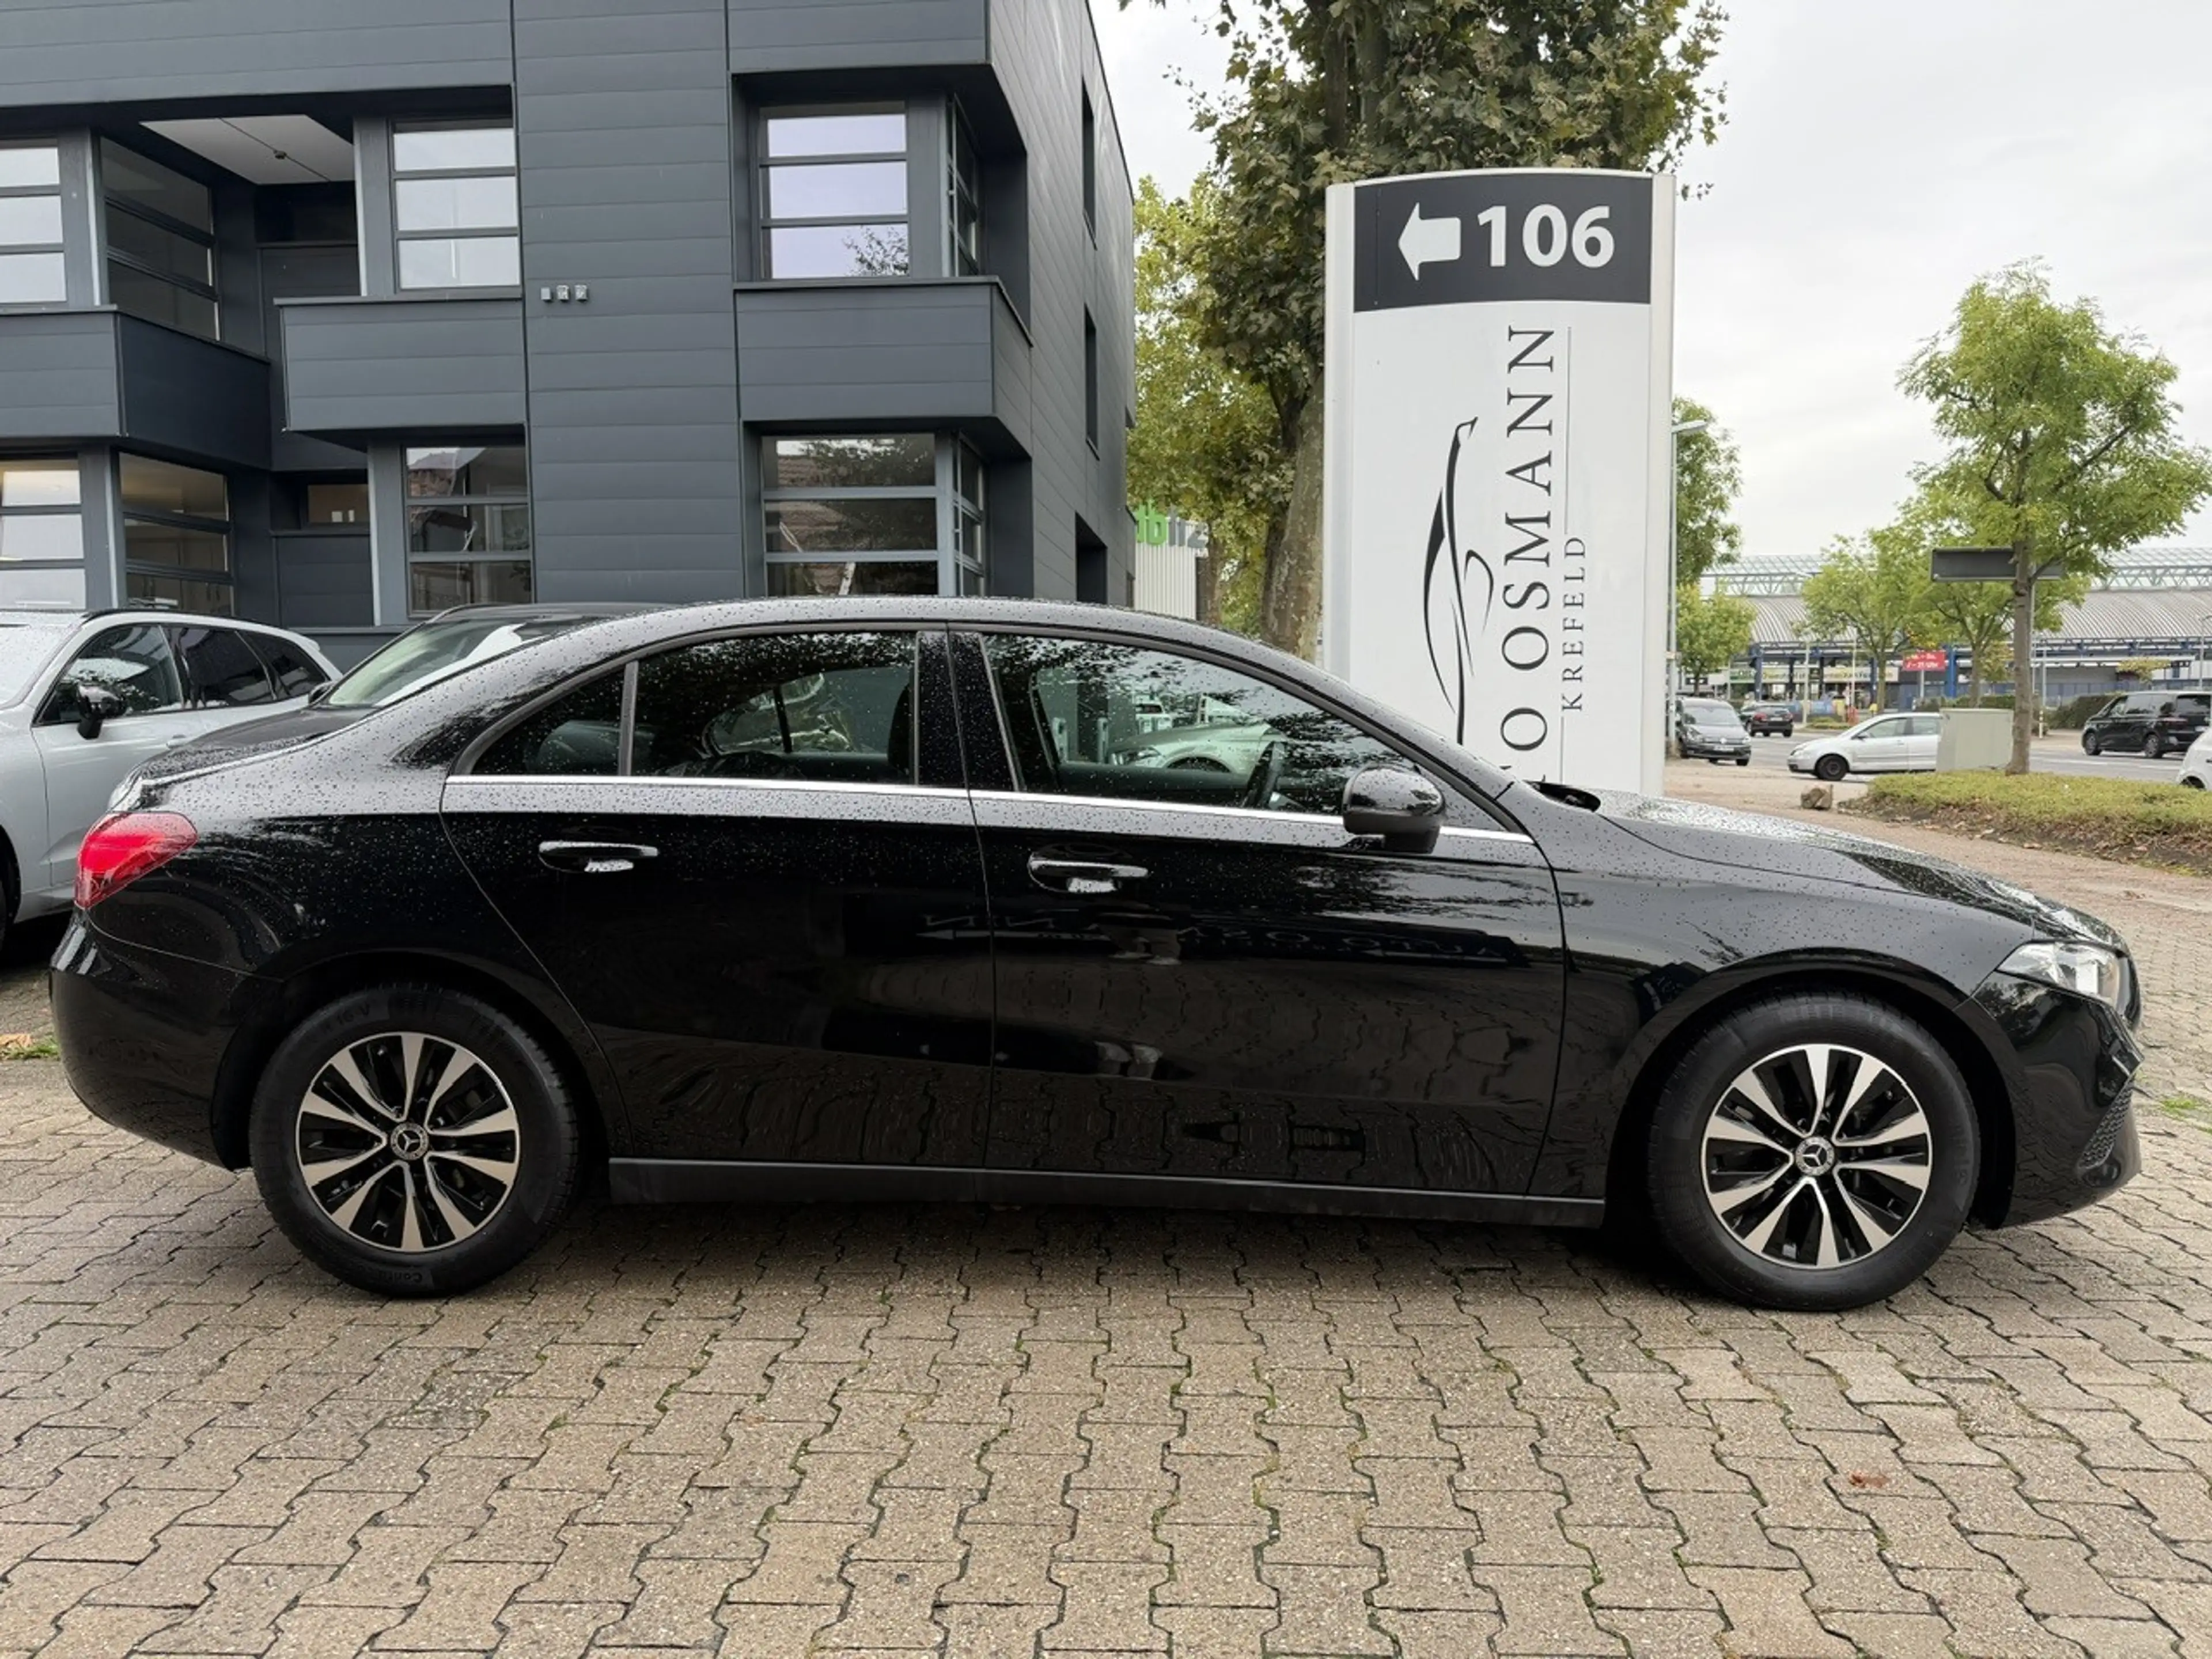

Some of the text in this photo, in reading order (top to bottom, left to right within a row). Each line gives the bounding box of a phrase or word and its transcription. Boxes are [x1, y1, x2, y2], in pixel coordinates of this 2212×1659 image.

[1478, 204, 1614, 267] 106
[1501, 324, 1555, 671] OSMANN
[1562, 538, 1585, 711] KREFELD
